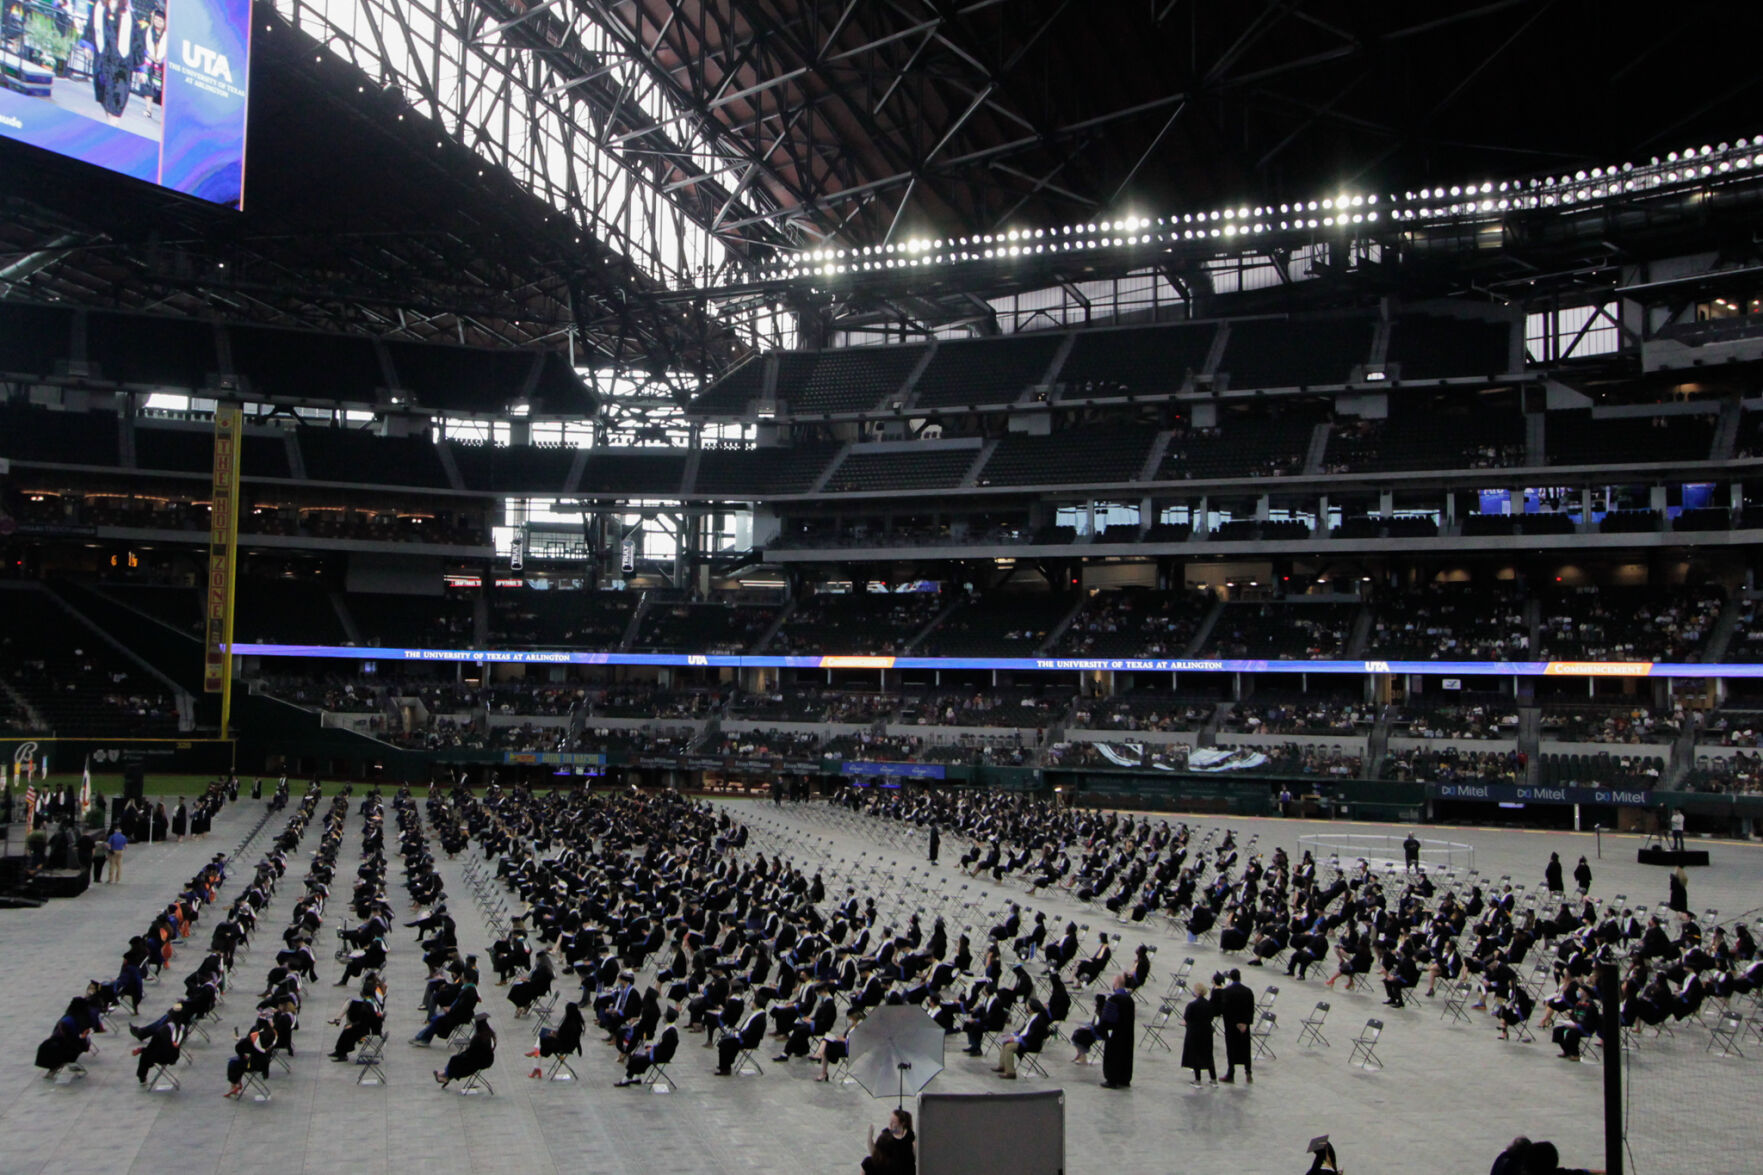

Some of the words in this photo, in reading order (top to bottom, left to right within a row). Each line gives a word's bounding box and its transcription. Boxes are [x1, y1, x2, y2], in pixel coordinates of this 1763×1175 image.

[182, 40, 232, 83] UTA
[168, 61, 180, 71] THE
[182, 67, 216, 85] UNIVERSITY
[227, 84, 245, 96] TEXAS
[194, 80, 229, 98] ARLINGTON
[423, 651, 470, 659] UNIVERSITY
[688, 655, 708, 665] UTA
[1037, 660, 1054, 668] THE
[1365, 661, 1390, 672] UTA
[1458, 785, 1488, 797] Mitel
[1533, 788, 1566, 800] Mitel
[1612, 790, 1646, 803] Mitel
